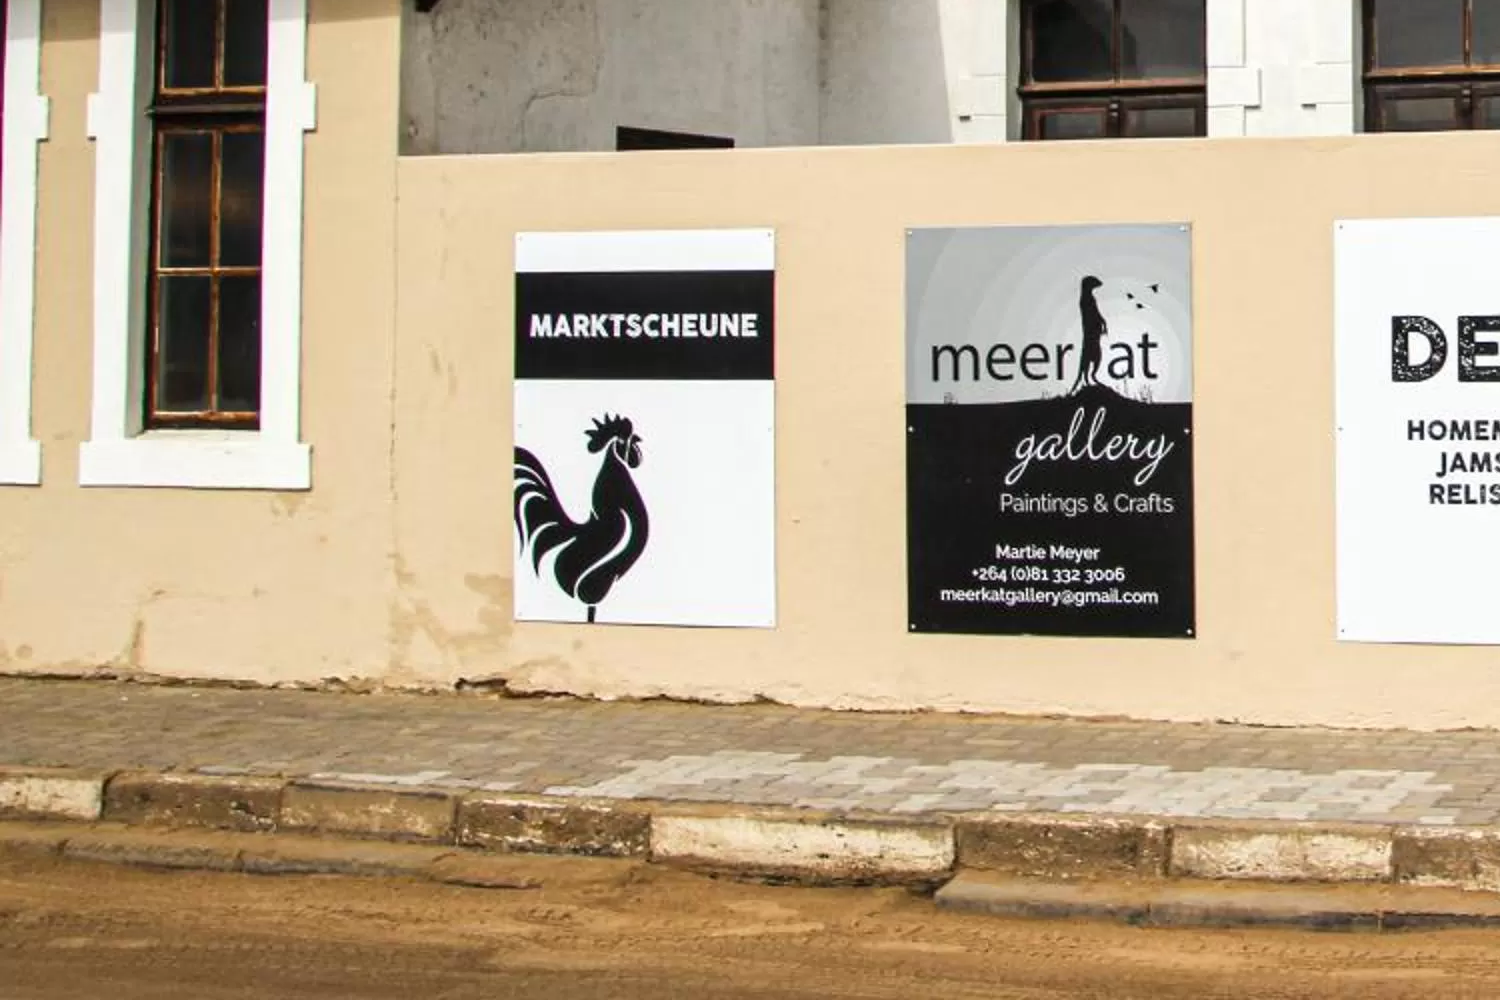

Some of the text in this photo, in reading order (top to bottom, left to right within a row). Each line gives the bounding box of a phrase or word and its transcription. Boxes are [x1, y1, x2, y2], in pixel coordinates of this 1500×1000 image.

[529, 312, 759, 338] MARKTSCHEUNE
[1003, 406, 1176, 486] gallery
[1000, 492, 1175, 517] Paintings & Crafts
[995, 544, 1100, 563] Martie Meyer
[971, 566, 1125, 584] +264 (0)81 332 3006
[940, 587, 1159, 607] meerkatgallery@gmail.com
